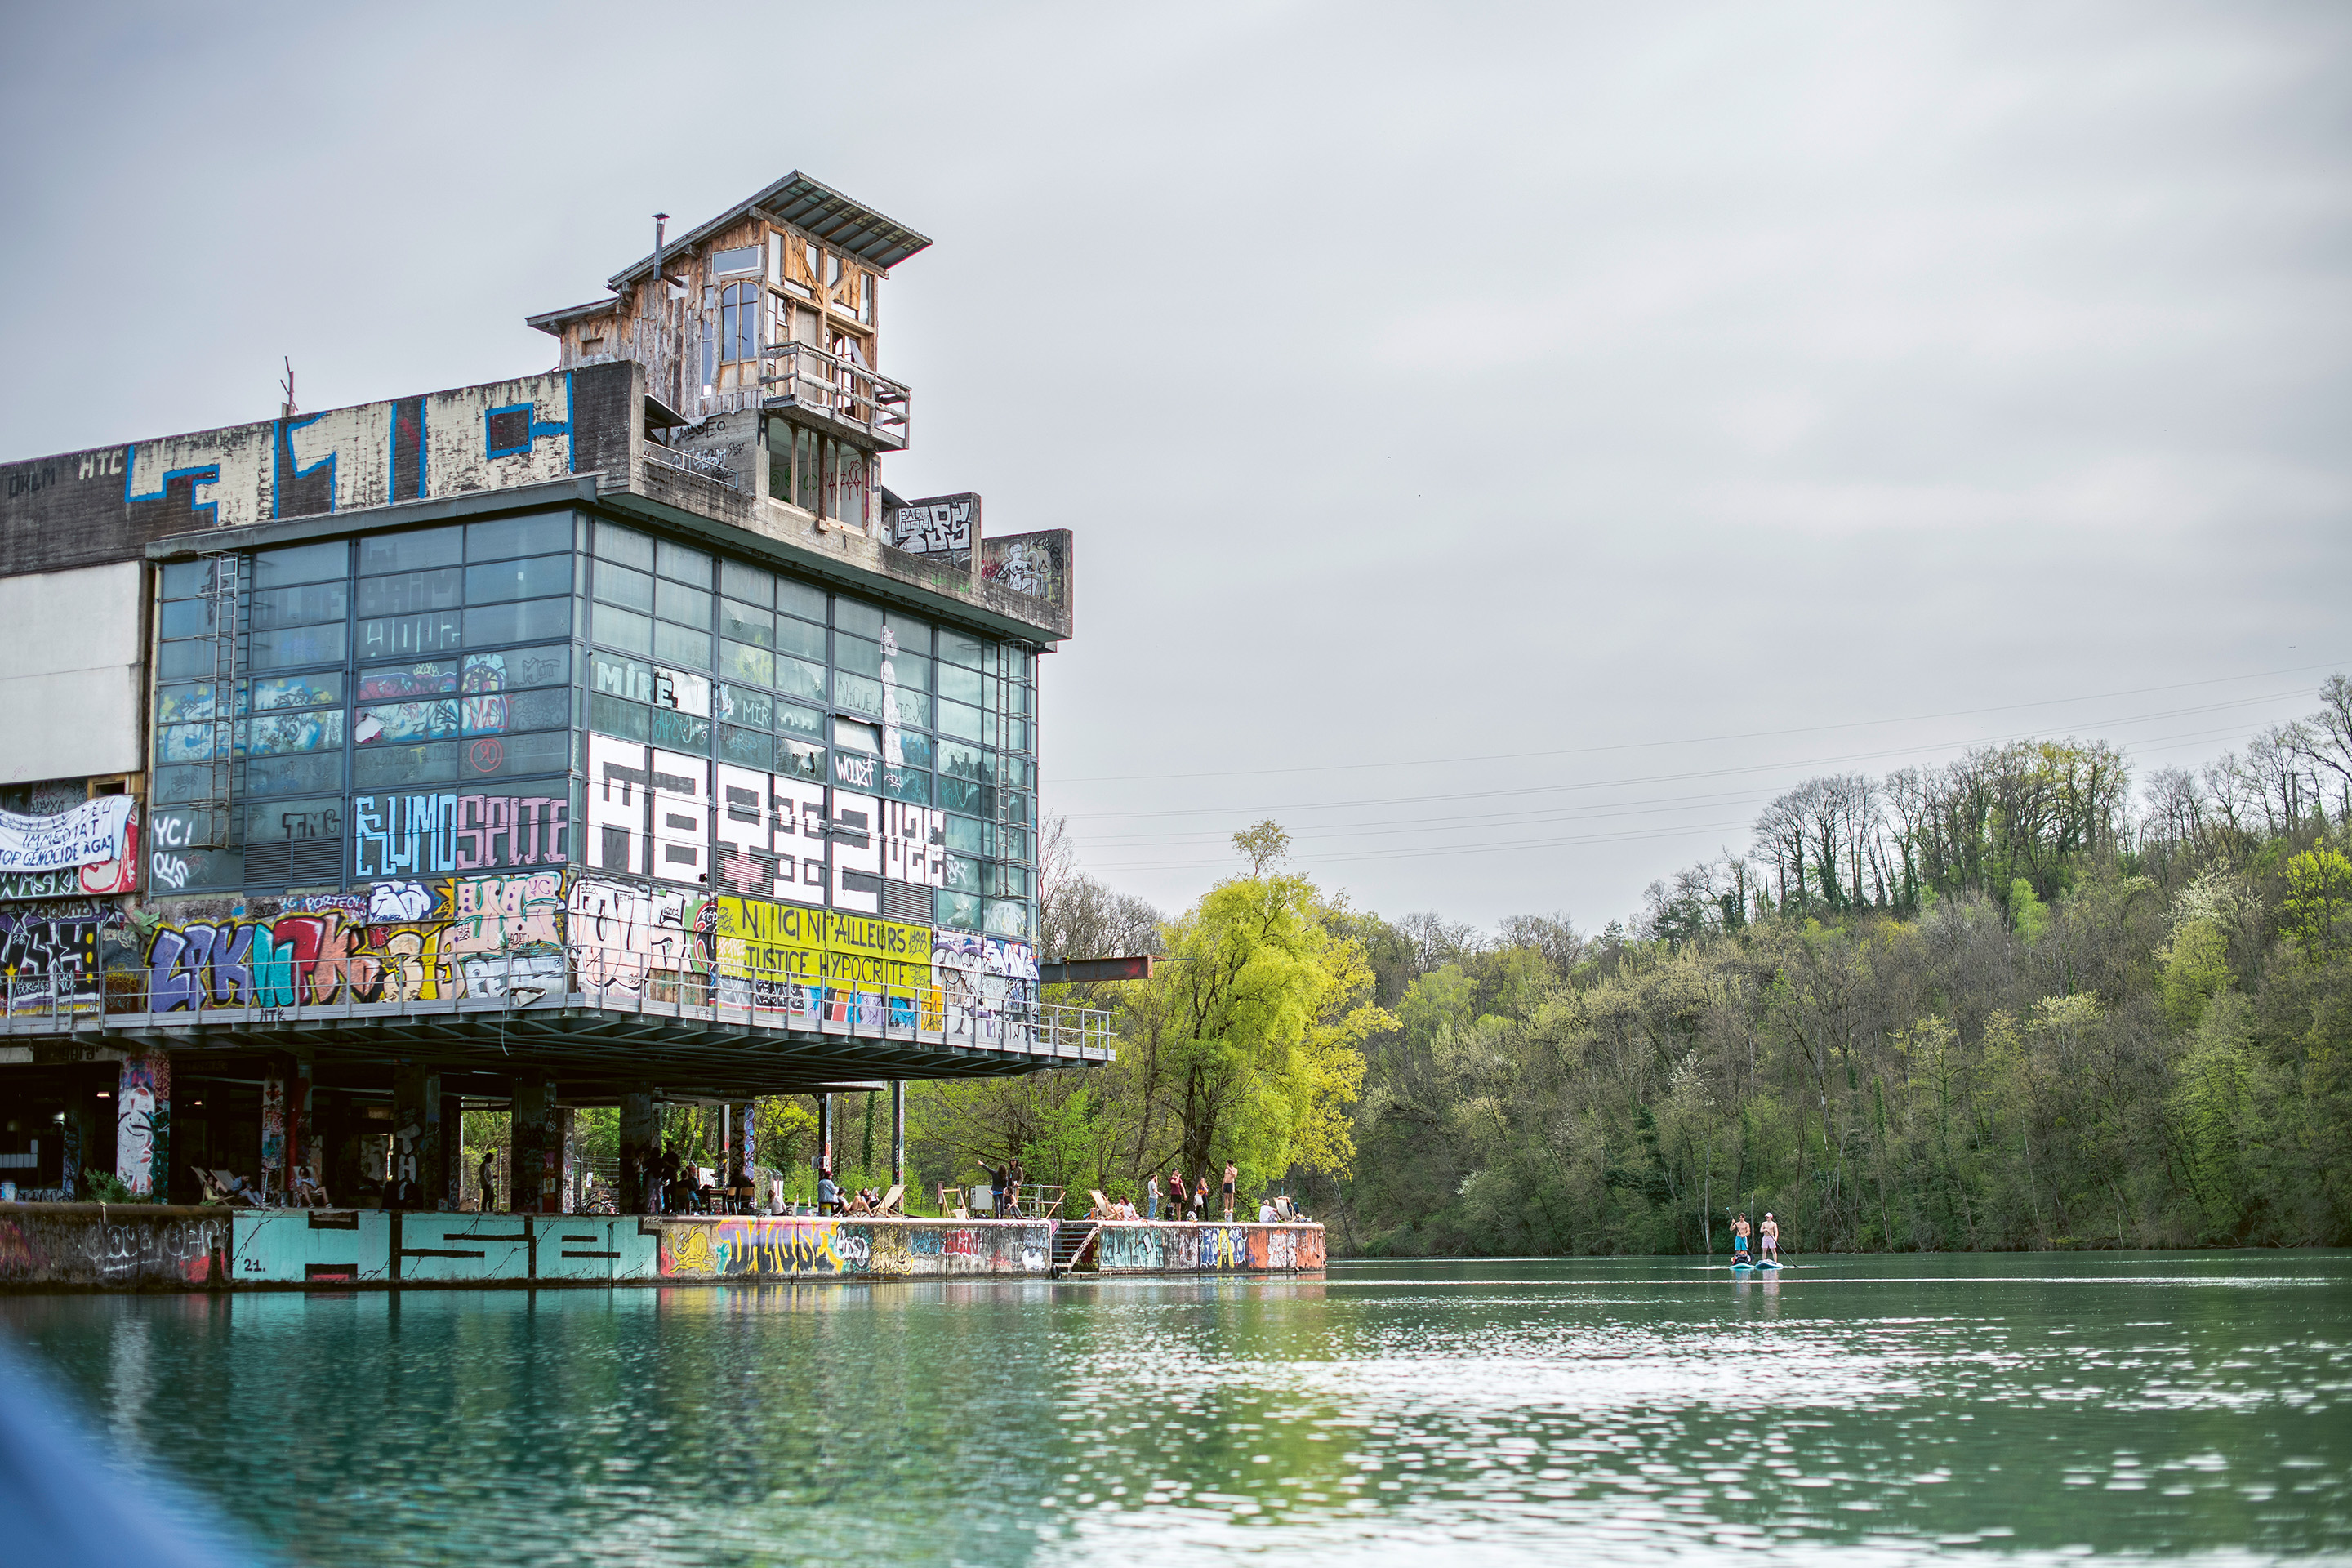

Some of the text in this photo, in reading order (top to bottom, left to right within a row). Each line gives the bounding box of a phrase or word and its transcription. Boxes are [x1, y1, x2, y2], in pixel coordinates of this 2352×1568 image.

[79, 449, 123, 480] HTC
[835, 915, 906, 954] AILLEURS
[744, 945, 809, 980] JUSTICE
[819, 952, 907, 988] HYPOCRITE
[243, 1258, 267, 1272] 21.
